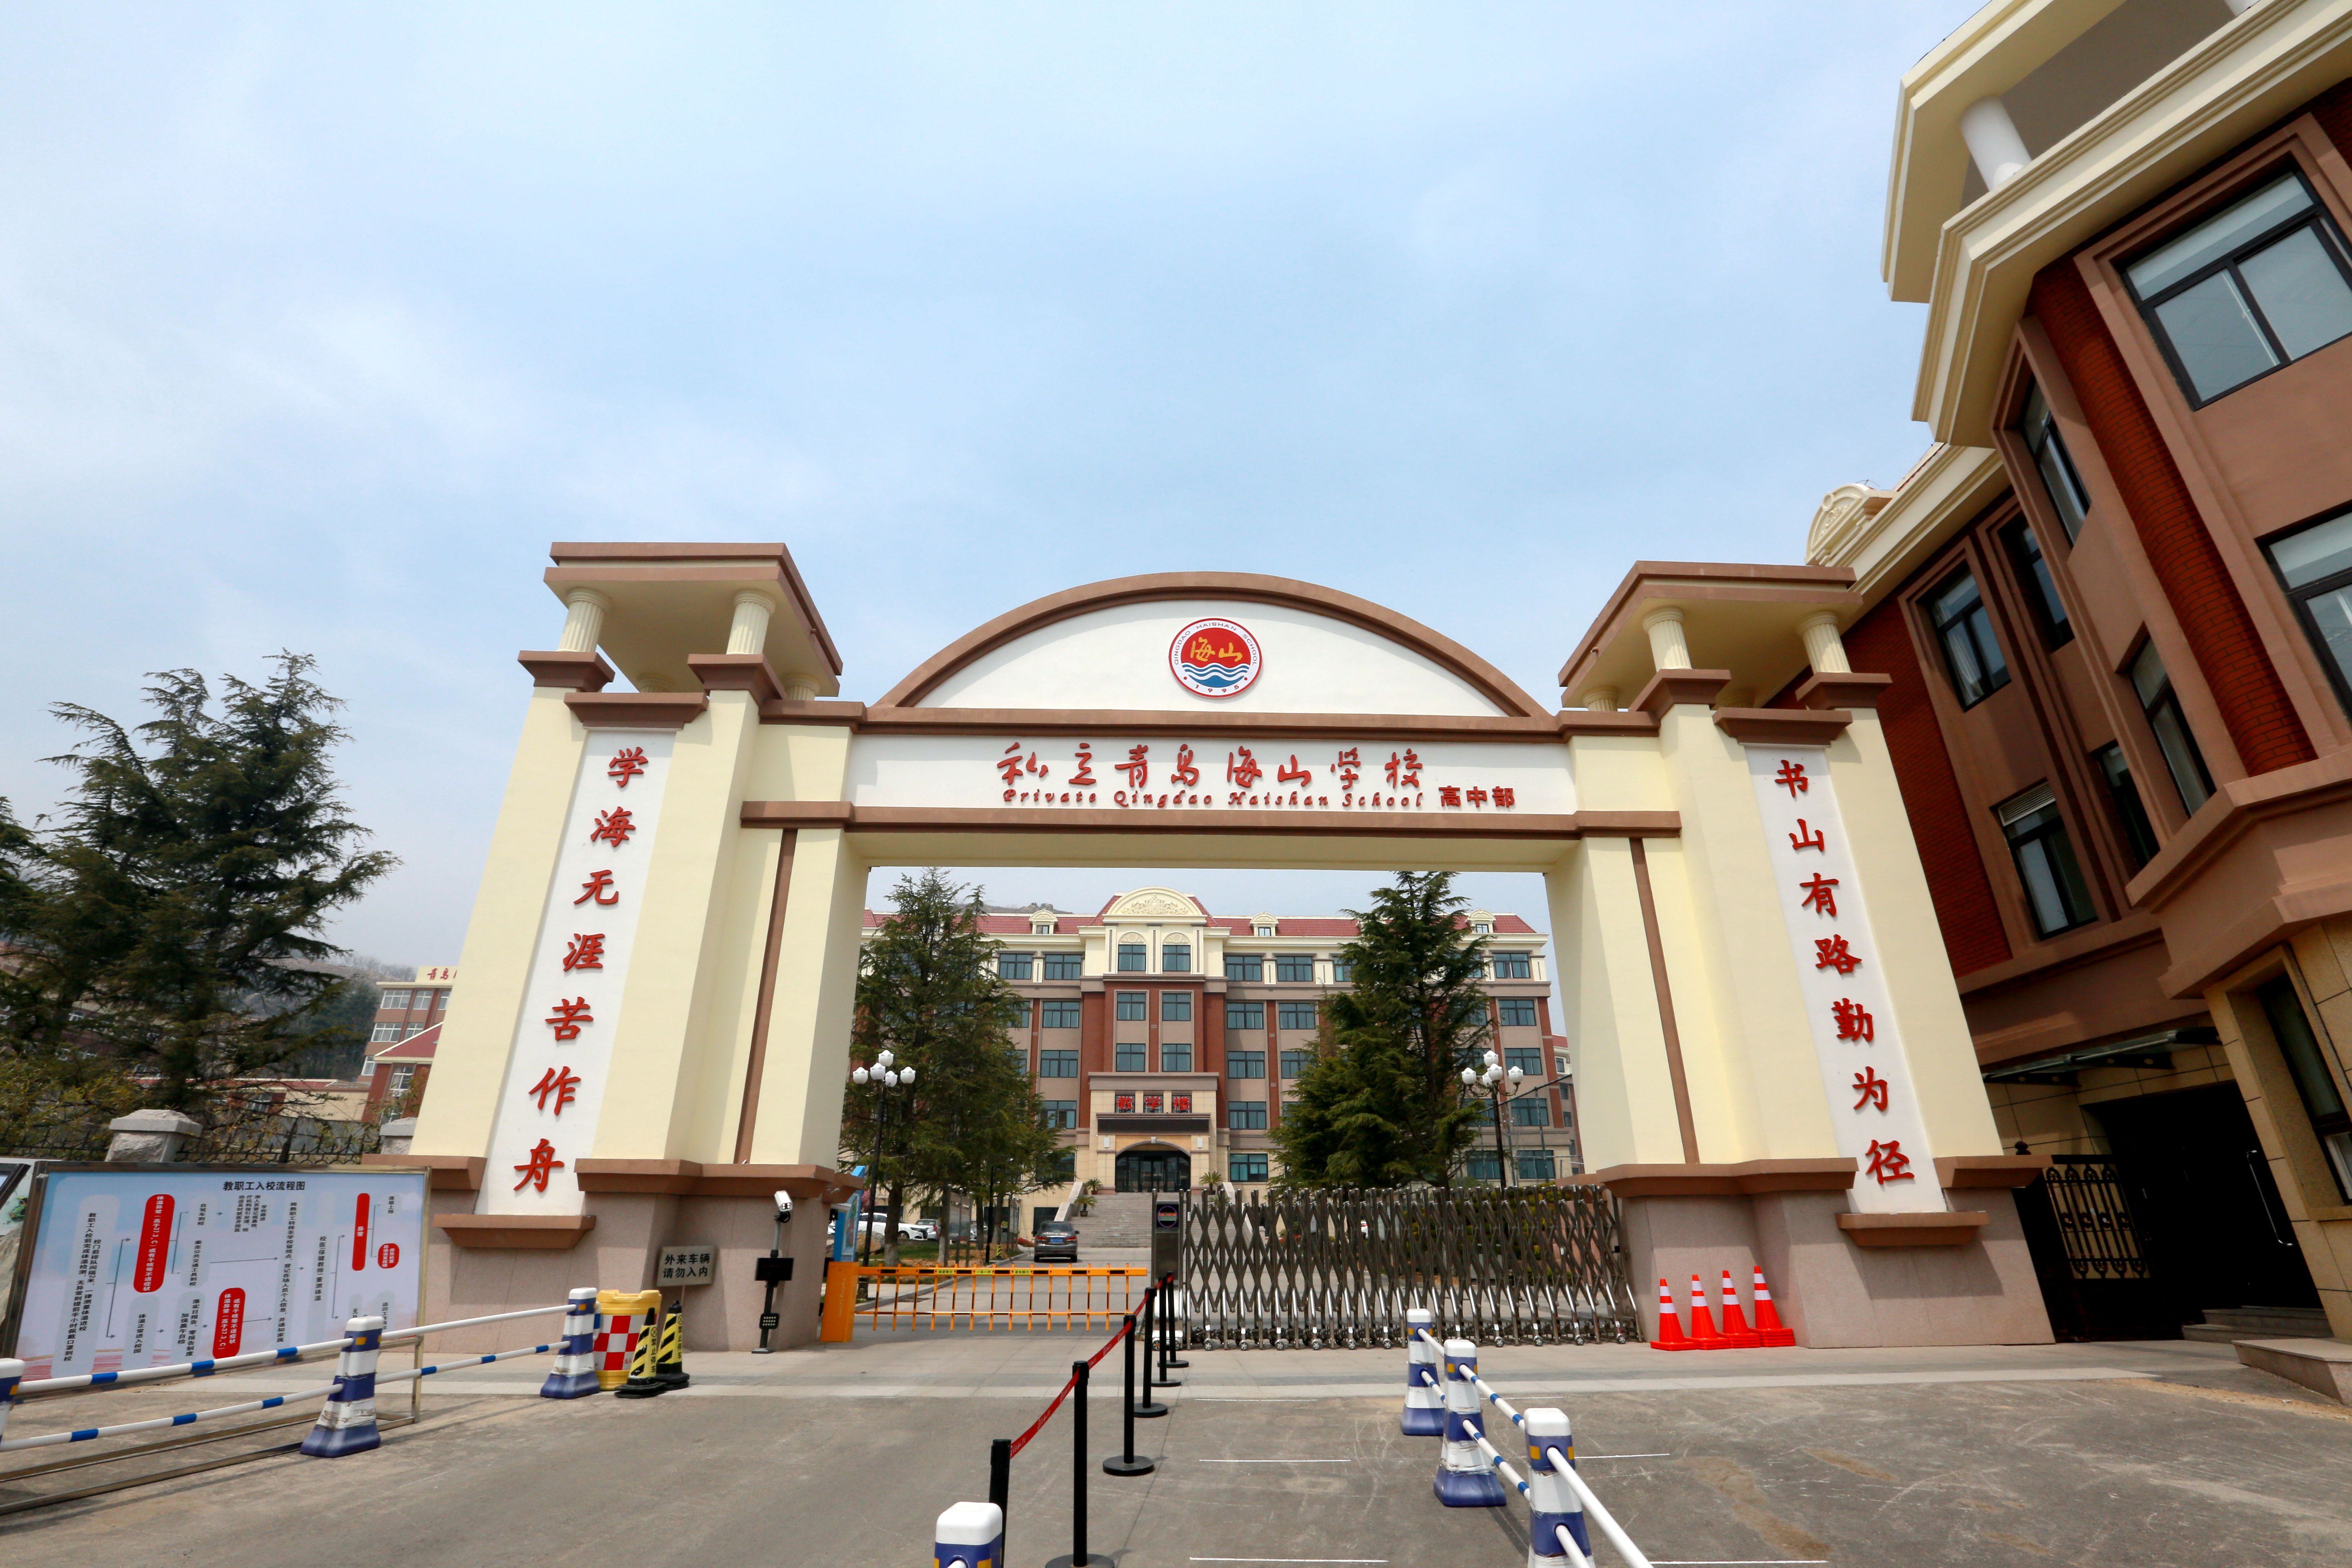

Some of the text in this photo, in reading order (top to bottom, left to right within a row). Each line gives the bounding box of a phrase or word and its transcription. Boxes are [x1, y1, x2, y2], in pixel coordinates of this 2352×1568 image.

[1174, 622, 1258, 666] QINGDAO HAISHAN SCHOOL
[1190, 637, 1243, 662] 海山
[1196, 684, 1239, 693] 1995
[1003, 788, 1423, 808] Private Qingdao Haishan School
[1438, 785, 1515, 808] 高中部
[427, 967, 457, 980] 青岛
[513, 746, 648, 1193] 学海无涯苦作舟
[1775, 759, 1915, 1185] 书山有路勤为径
[1116, 1095, 1191, 1111] 教学楼
[223, 1181, 305, 1191] 教职工入校流程图
[197, 1203, 207, 1225] 自驾车到校
[356, 1226, 364, 1237] 异常
[189, 1240, 202, 1286] 乘坐公共交通工具到校
[664, 1253, 710, 1265] 外来车辆
[663, 1266, 708, 1278] 请勿入内
[134, 1314, 147, 1354] 体温正常进入校园
